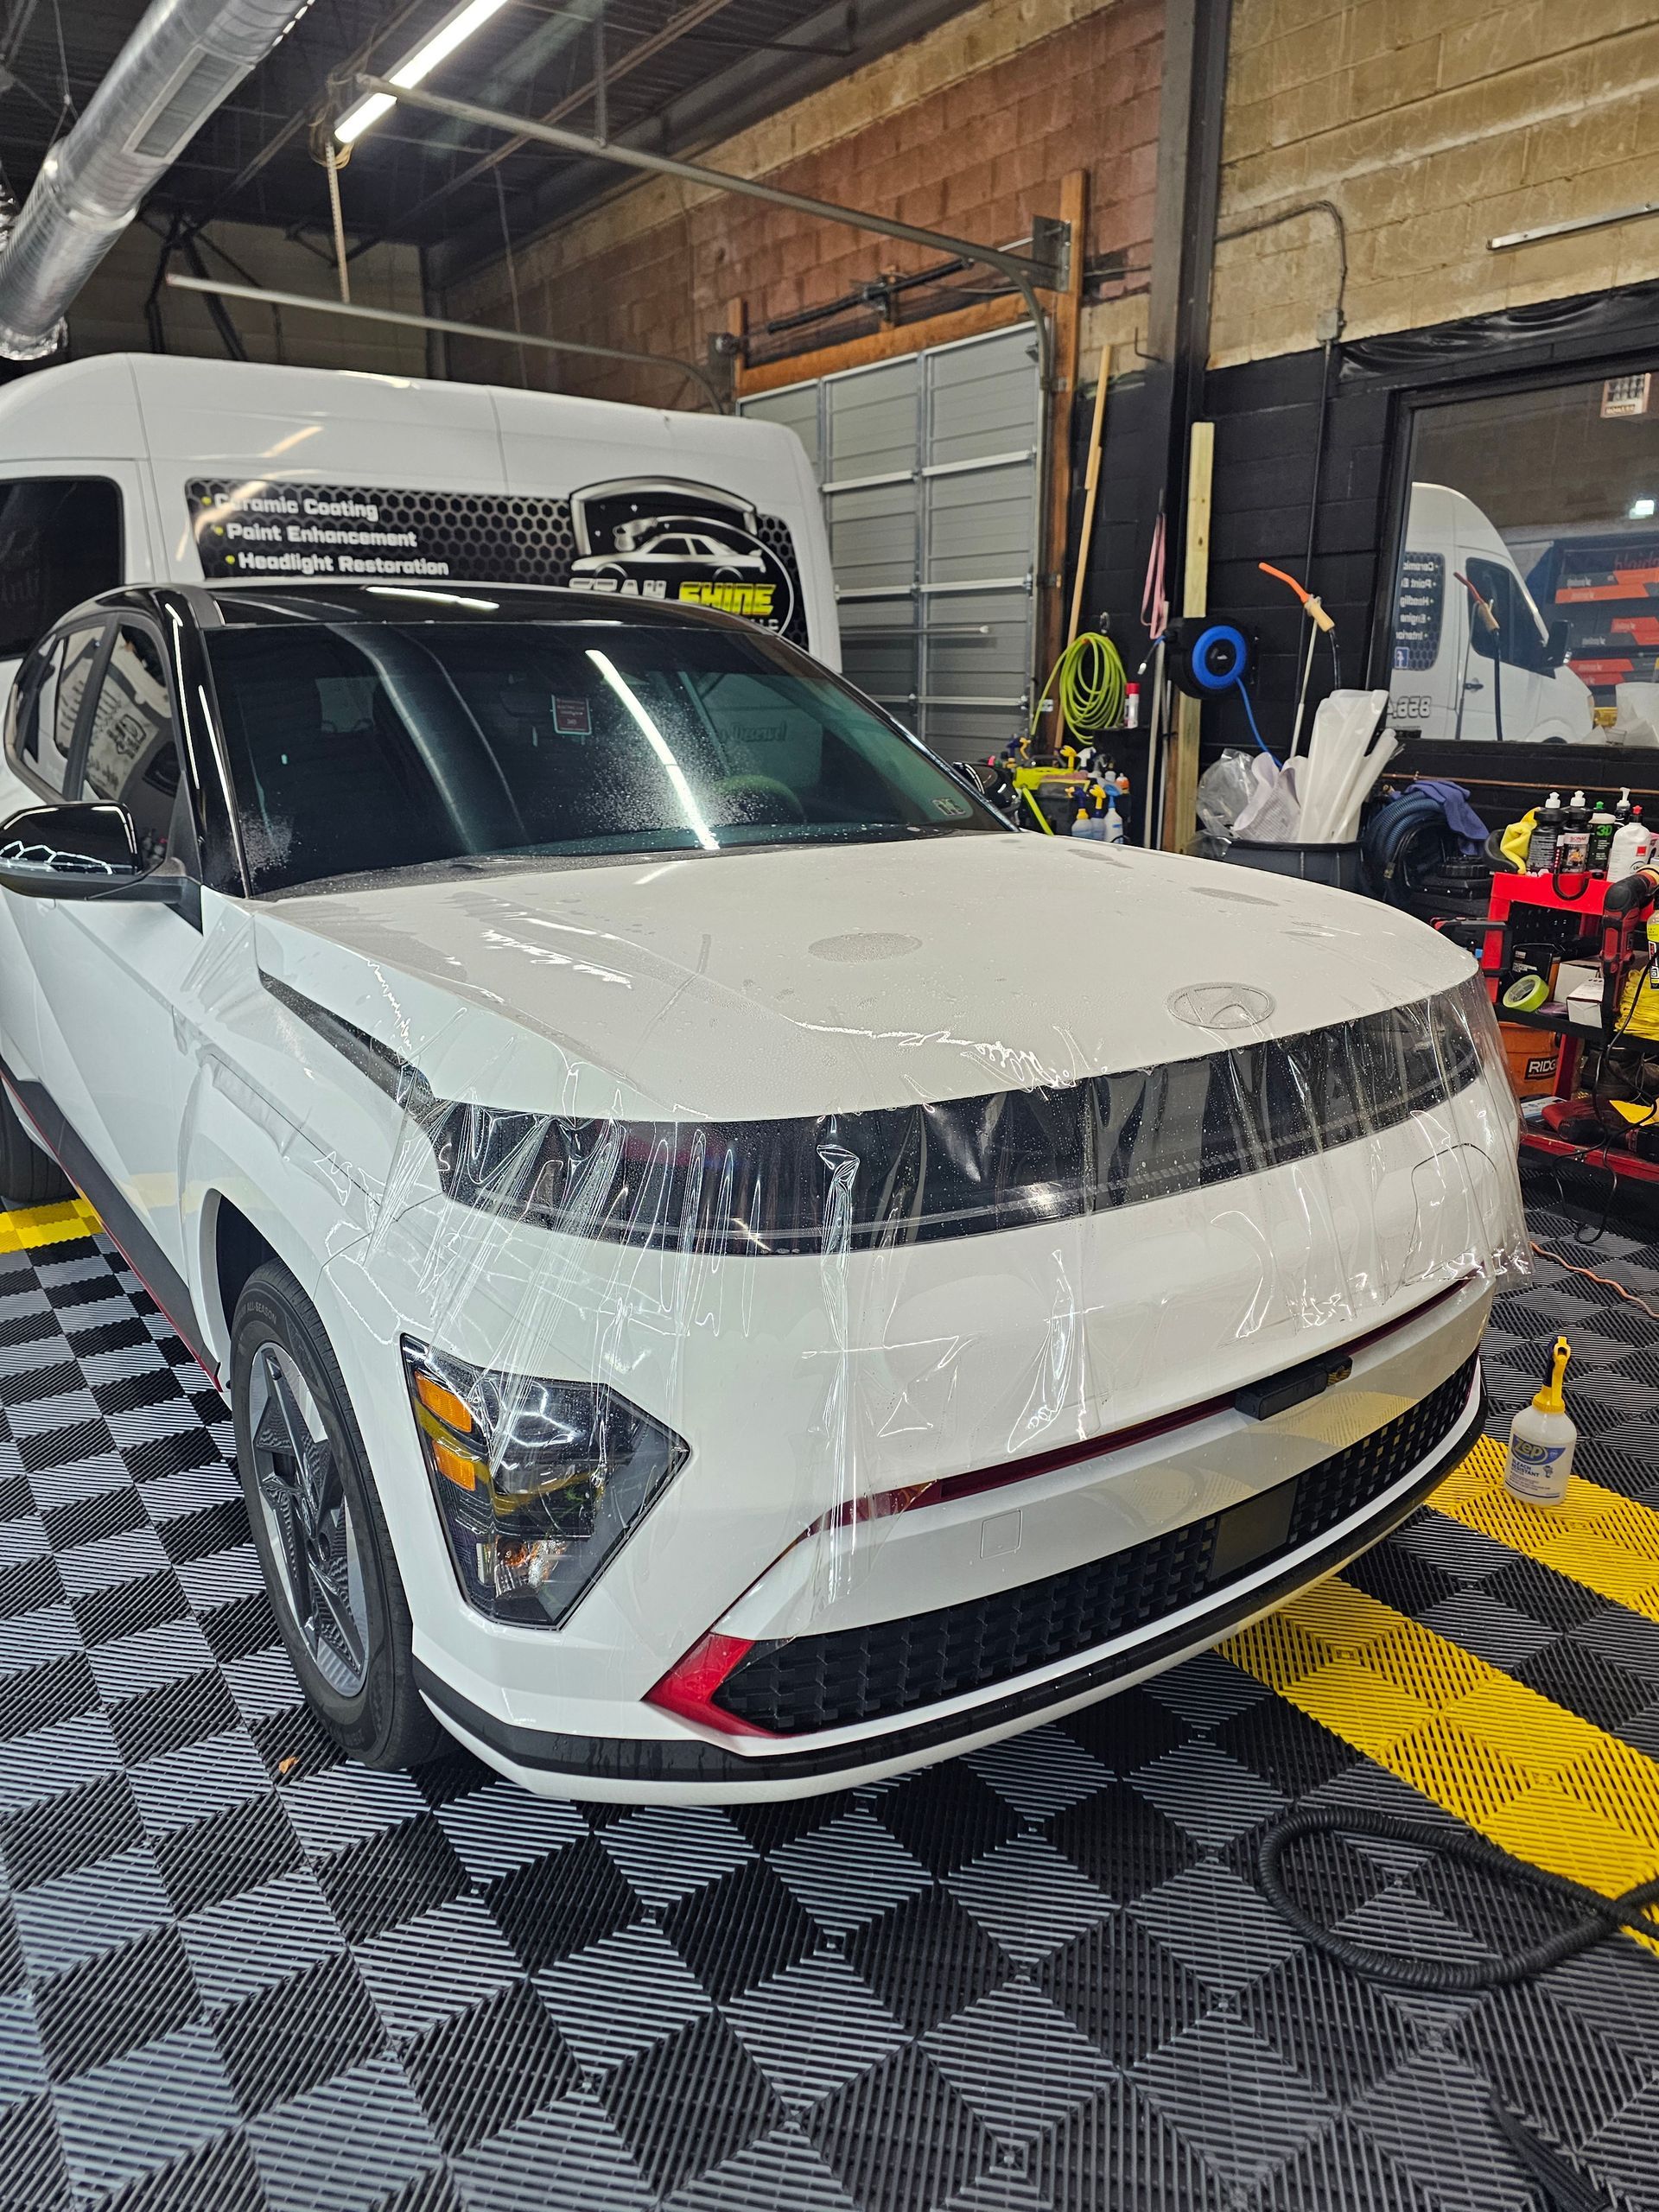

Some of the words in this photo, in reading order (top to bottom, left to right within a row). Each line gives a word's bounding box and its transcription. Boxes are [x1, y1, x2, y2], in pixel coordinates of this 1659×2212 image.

[214, 493, 299, 514] Ceramic
[303, 499, 379, 522] Coating
[226, 522, 283, 542] Paint
[286, 524, 417, 547] Enhancement
[238, 551, 334, 575] Headlight
[338, 556, 449, 575] Restoration
[678, 582, 777, 615] SHINE
[1596, 824, 1612, 836] 3D
[247, 1301, 276, 1325] ALL-SEASON
